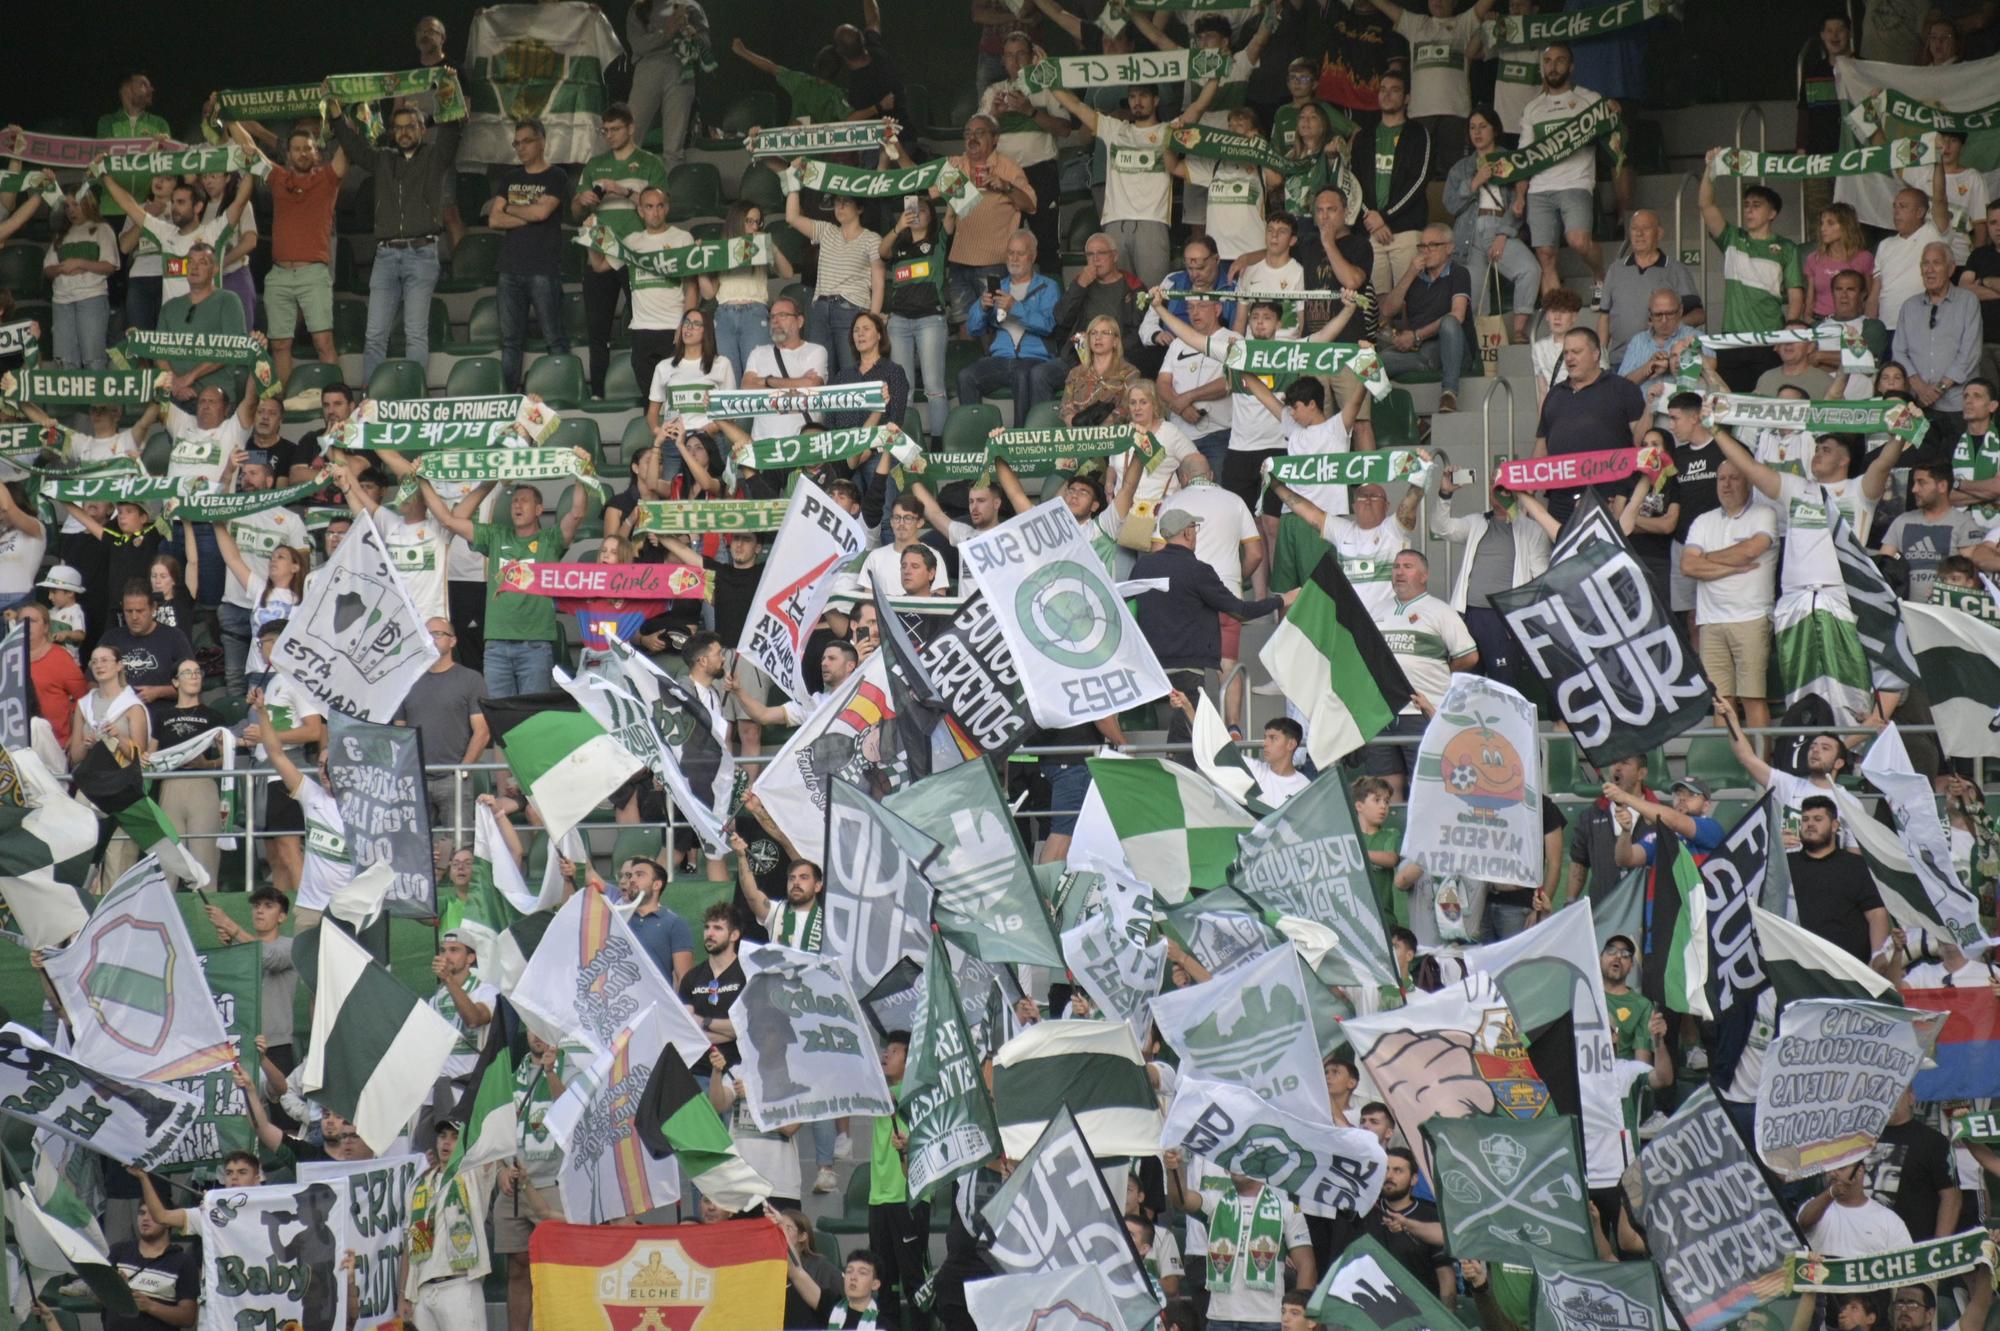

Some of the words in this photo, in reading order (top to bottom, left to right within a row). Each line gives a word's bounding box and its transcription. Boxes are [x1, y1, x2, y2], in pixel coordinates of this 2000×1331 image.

[1530, 12, 1591, 39] ELCHE
[1599, 1, 1636, 31] CF
[332, 76, 377, 93] LCHE
[1893, 101, 1956, 128] ELCHE
[110, 153, 174, 173] ELCHE
[181, 147, 219, 172] CF
[1764, 155, 1833, 175] ELCHE
[1840, 151, 1876, 172] CF
[828, 174, 891, 196] ELCHE
[898, 165, 939, 189] CF
[686, 245, 721, 269] CF
[897, 270, 910, 279] TM
[1251, 344, 1311, 372] ELCHE
[1315, 347, 1354, 372] CF
[34, 375, 96, 397] ELCHE
[103, 376, 140, 397] C.F.
[379, 401, 431, 421] SOMOS
[433, 403, 451, 420] de
[452, 400, 518, 420] PRIMERA
[1054, 429, 1066, 442] A
[442, 450, 557, 469] ELCHE
[1278, 455, 1341, 483] ELCHE
[1346, 455, 1384, 481] CF
[1508, 459, 1577, 484] ELCHE
[425, 469, 471, 479] CLUB
[477, 469, 498, 478] DE
[541, 570, 606, 590] ELCHE
[284, 637, 337, 680] ESTÁ
[922, 632, 1026, 751] SEREMOS
[1845, 1253, 1917, 1283] ELCHE
[1928, 1241, 1972, 1269] C.F.
[214, 1254, 312, 1302] Baby
[630, 1286, 679, 1300] ELCHE
